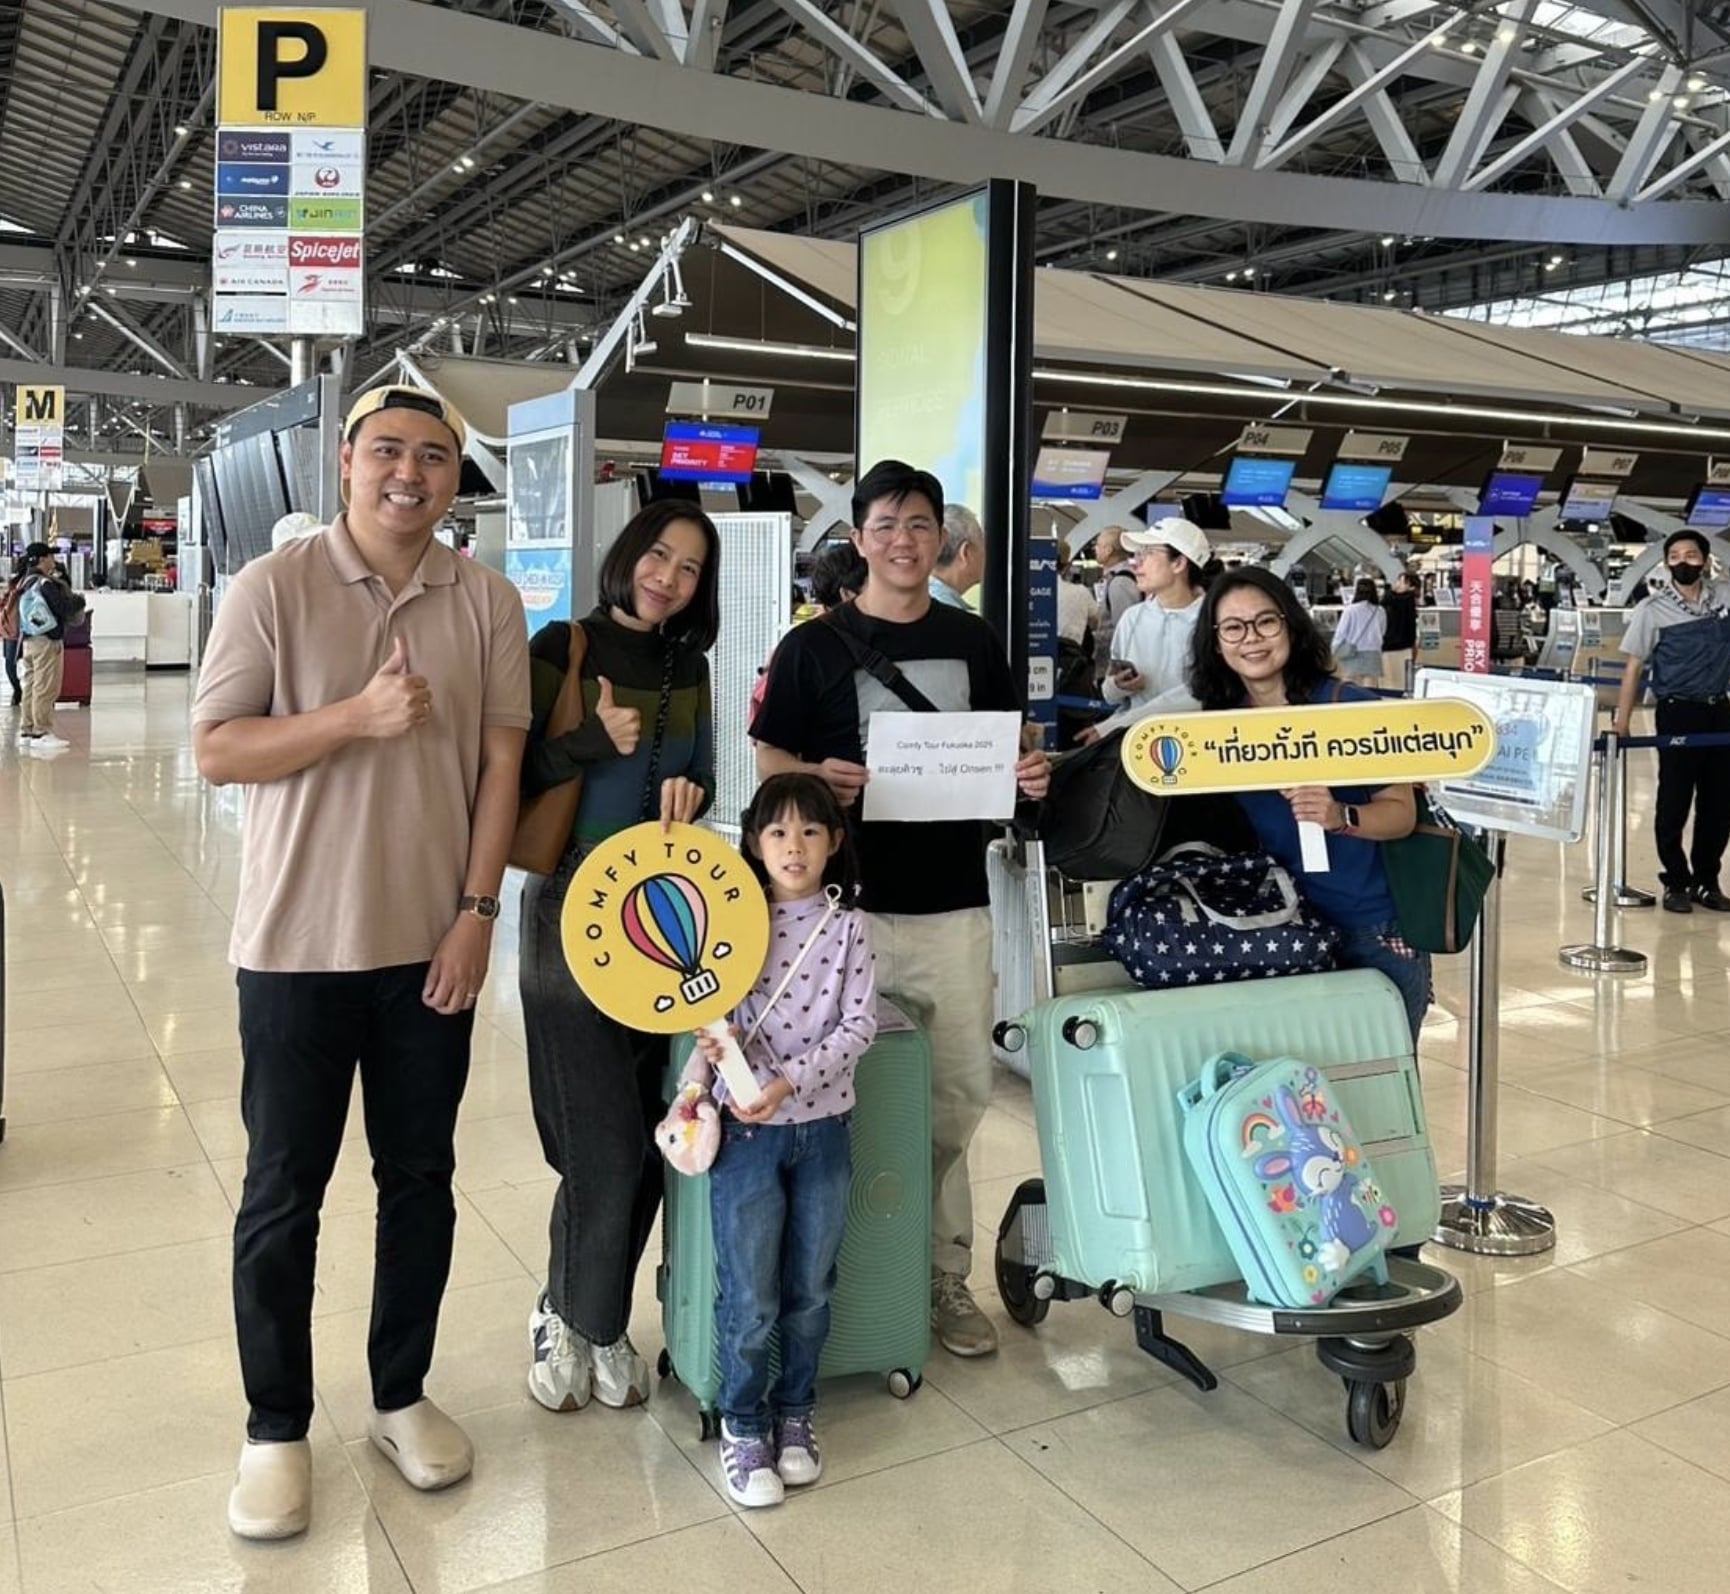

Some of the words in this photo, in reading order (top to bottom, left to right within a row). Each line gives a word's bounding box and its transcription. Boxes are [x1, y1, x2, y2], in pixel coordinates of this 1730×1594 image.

[256, 20, 328, 112] P
[264, 111, 293, 121] ROW
[25, 390, 56, 420] M
[733, 394, 766, 411] P01
[1091, 420, 1120, 437] P03
[1243, 432, 1270, 446] P04
[1029, 586, 1052, 596] GAGE
[1464, 638, 1475, 672] PRIO
[1474, 639, 1487, 668] SKY
[585, 849, 638, 967] COMFY
[663, 842, 741, 903] TOUR
